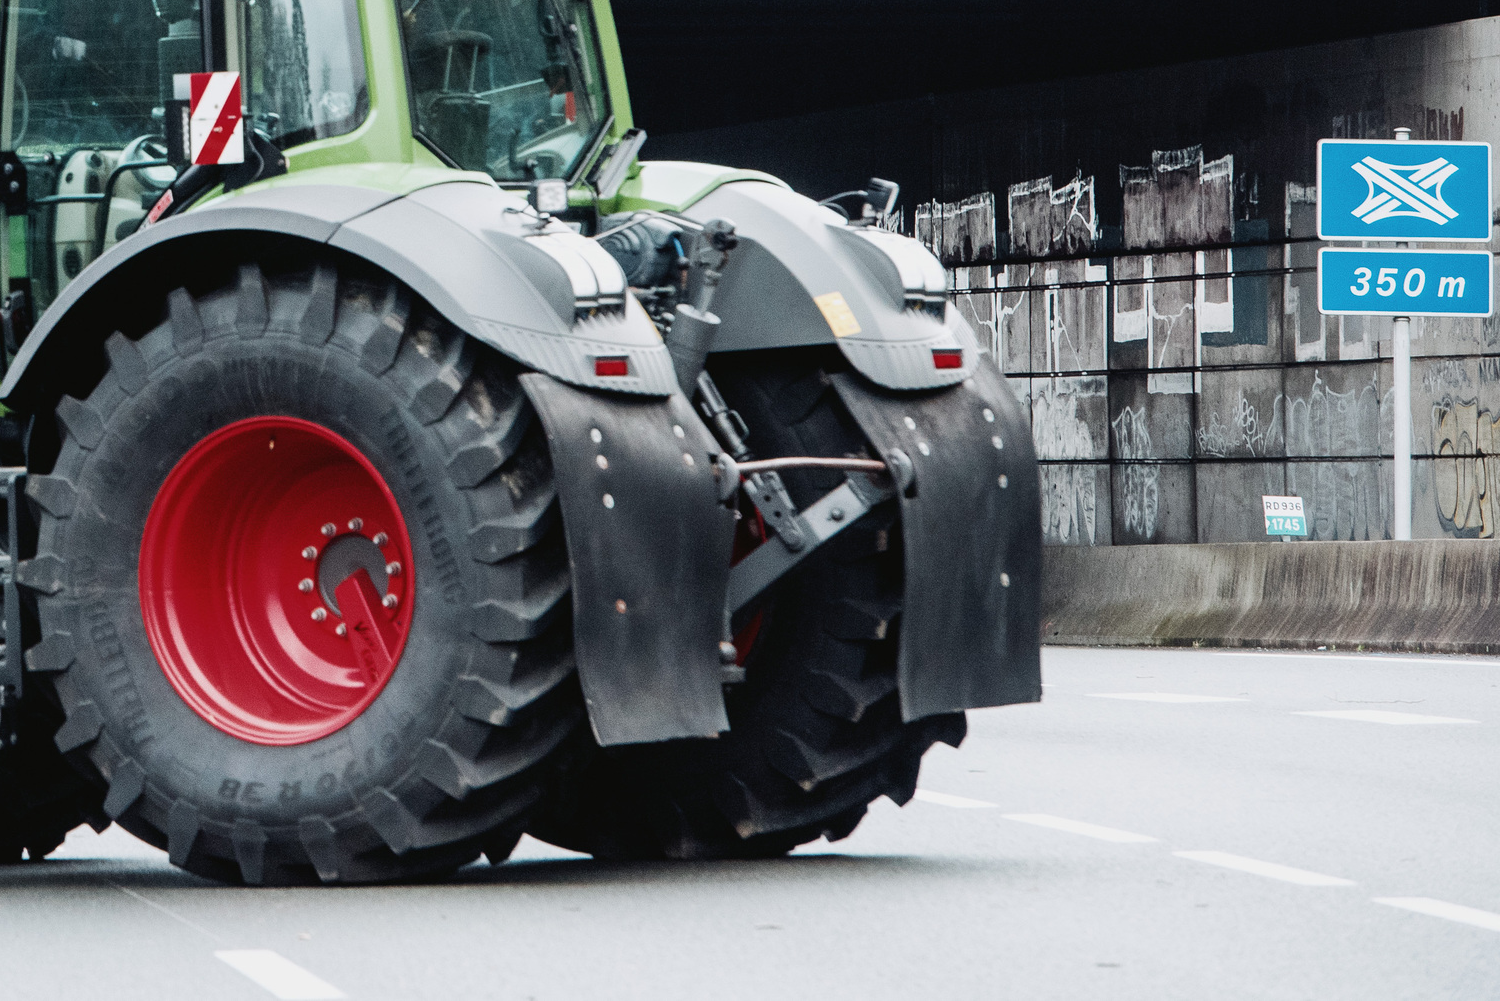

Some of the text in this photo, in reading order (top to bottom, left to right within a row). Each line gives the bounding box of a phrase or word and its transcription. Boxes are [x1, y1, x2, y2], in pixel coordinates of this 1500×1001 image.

[1350, 267, 1465, 297] 350 m
[1272, 518, 1300, 531] 1745
